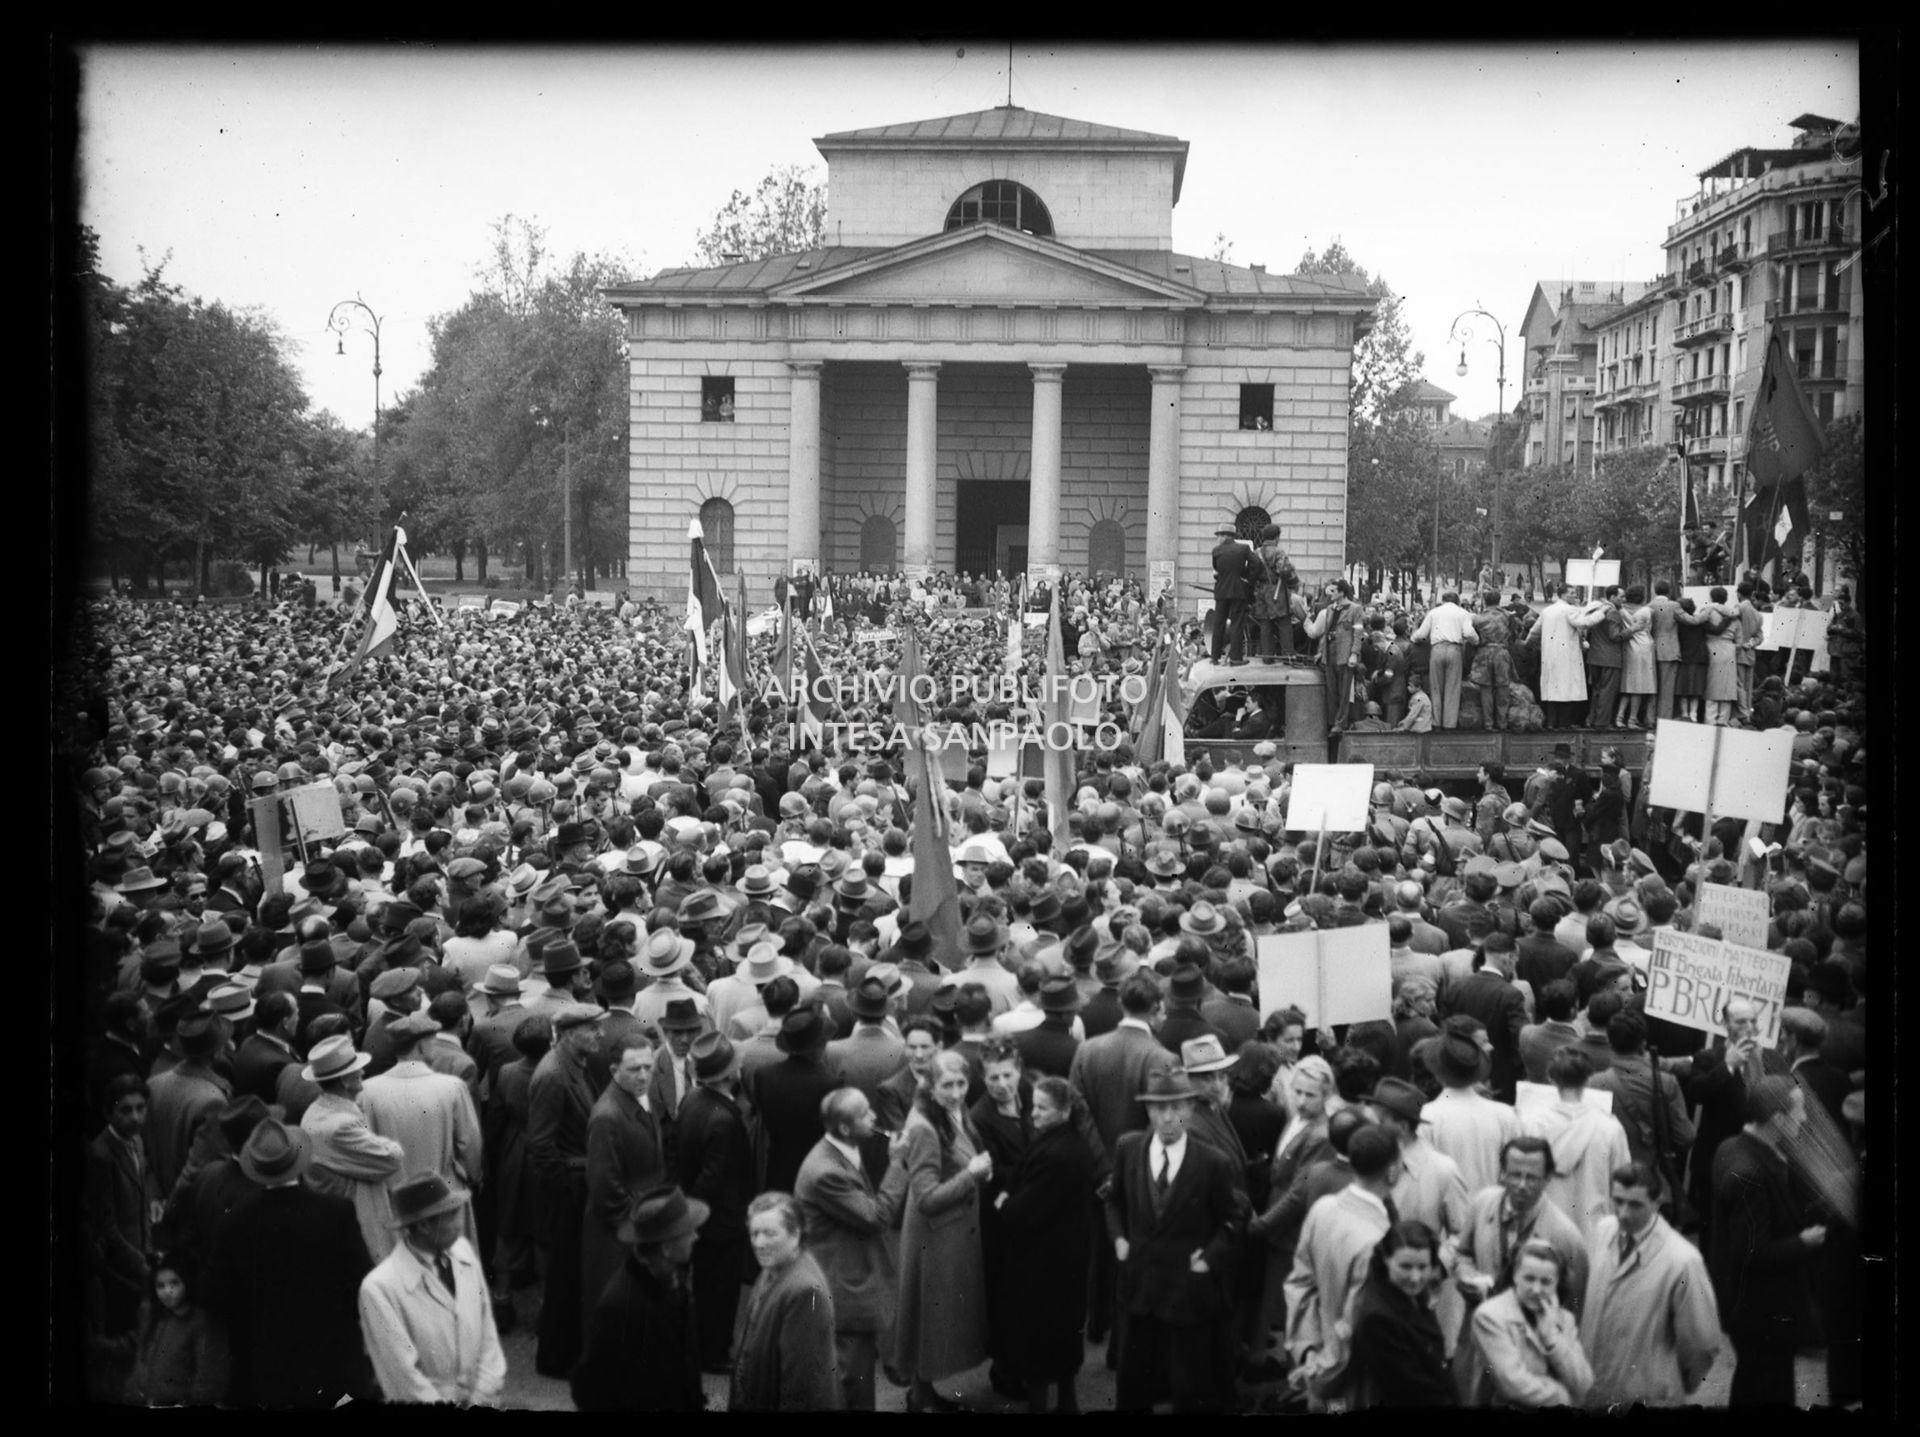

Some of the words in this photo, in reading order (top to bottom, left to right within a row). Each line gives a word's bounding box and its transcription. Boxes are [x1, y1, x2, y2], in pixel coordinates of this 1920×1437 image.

[1658, 931, 1720, 958] FORMAZIONI
[1723, 948, 1786, 976] MATTEOTTI
[1676, 953, 1722, 982] Brigata
